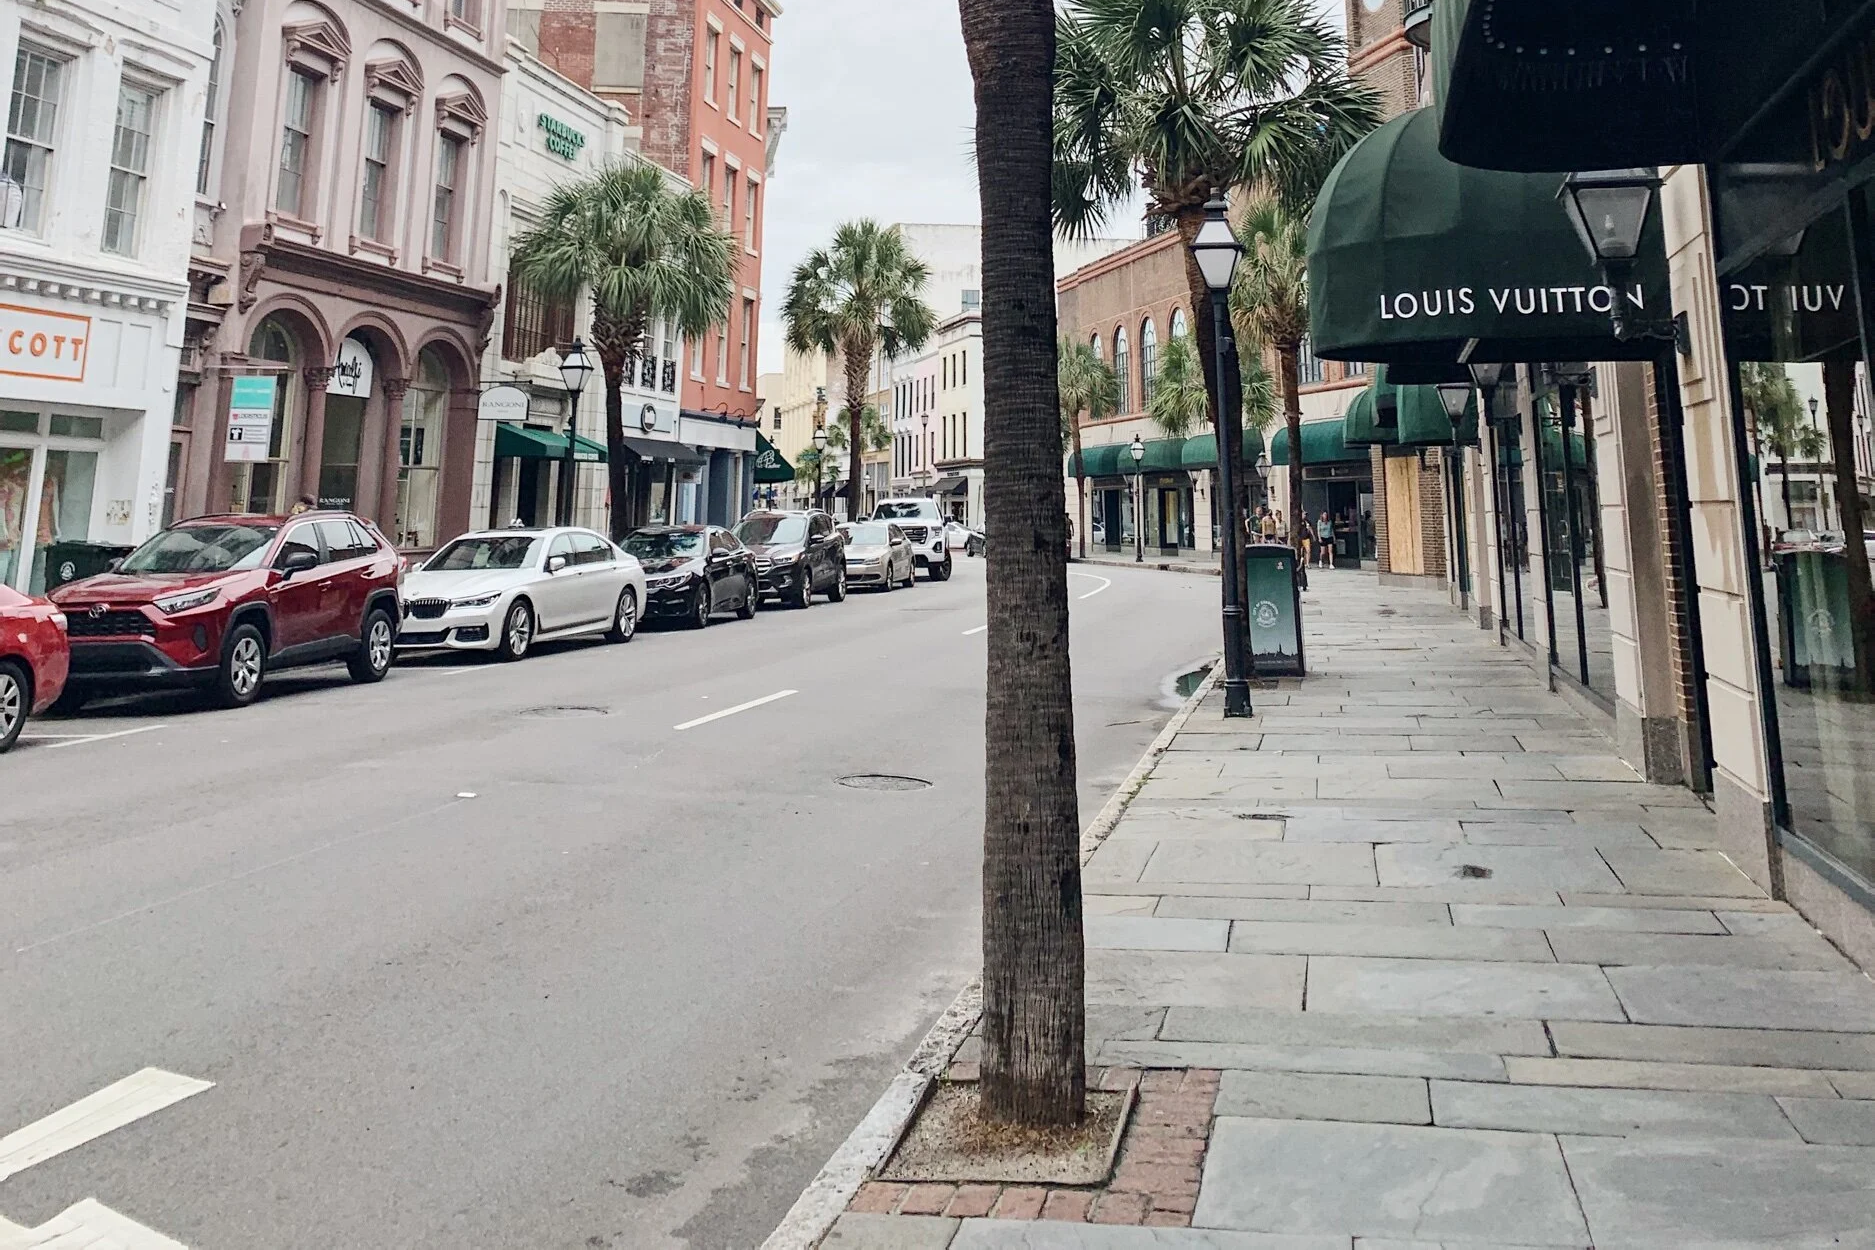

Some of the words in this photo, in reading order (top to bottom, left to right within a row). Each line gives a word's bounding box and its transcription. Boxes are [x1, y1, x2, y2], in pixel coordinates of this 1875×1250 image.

[538, 113, 585, 148] STARBUCKS
[1380, 287, 1475, 320] LOUIS
[1488, 283, 1645, 316] VUITTON
[0, 328, 84, 362] COTT
